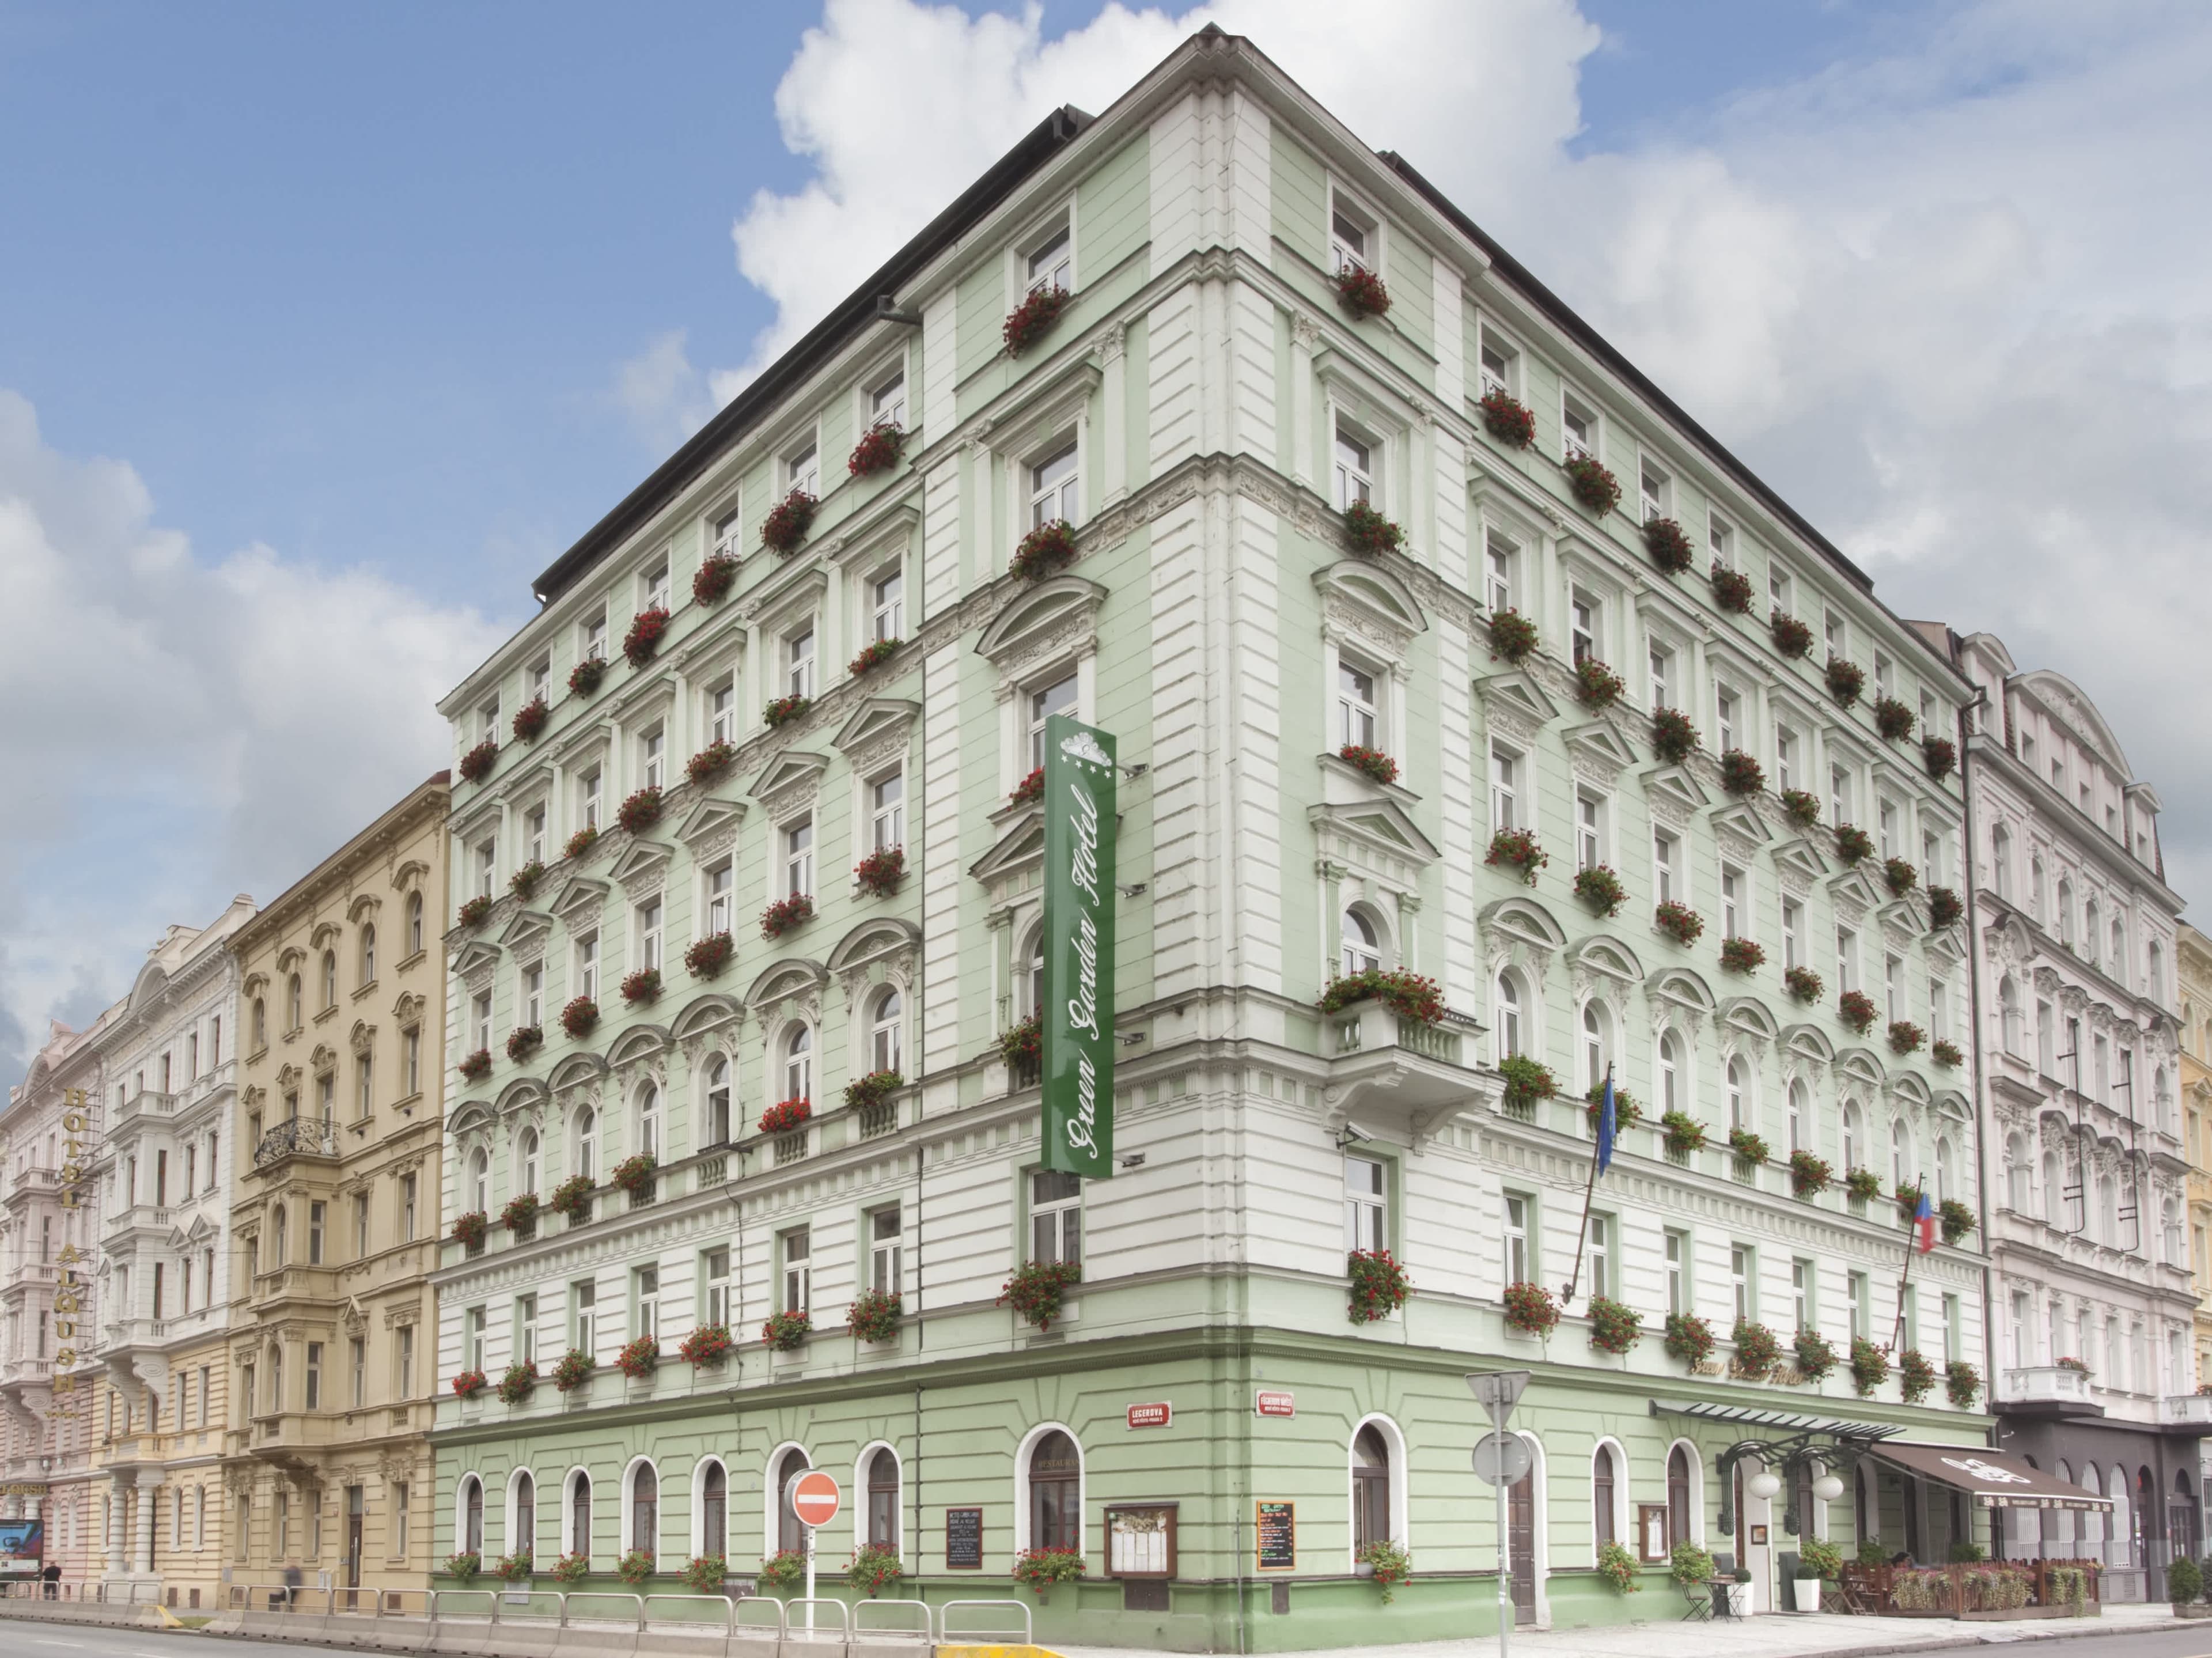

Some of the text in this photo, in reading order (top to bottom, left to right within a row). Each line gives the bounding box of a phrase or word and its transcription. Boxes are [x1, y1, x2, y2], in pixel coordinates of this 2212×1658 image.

[1067, 783, 1100, 1159] Green Garden Hotel
[52, 1087, 87, 1393] HOTEL ALQUSH
[1132, 1408, 1162, 1418] LEGEROVA
